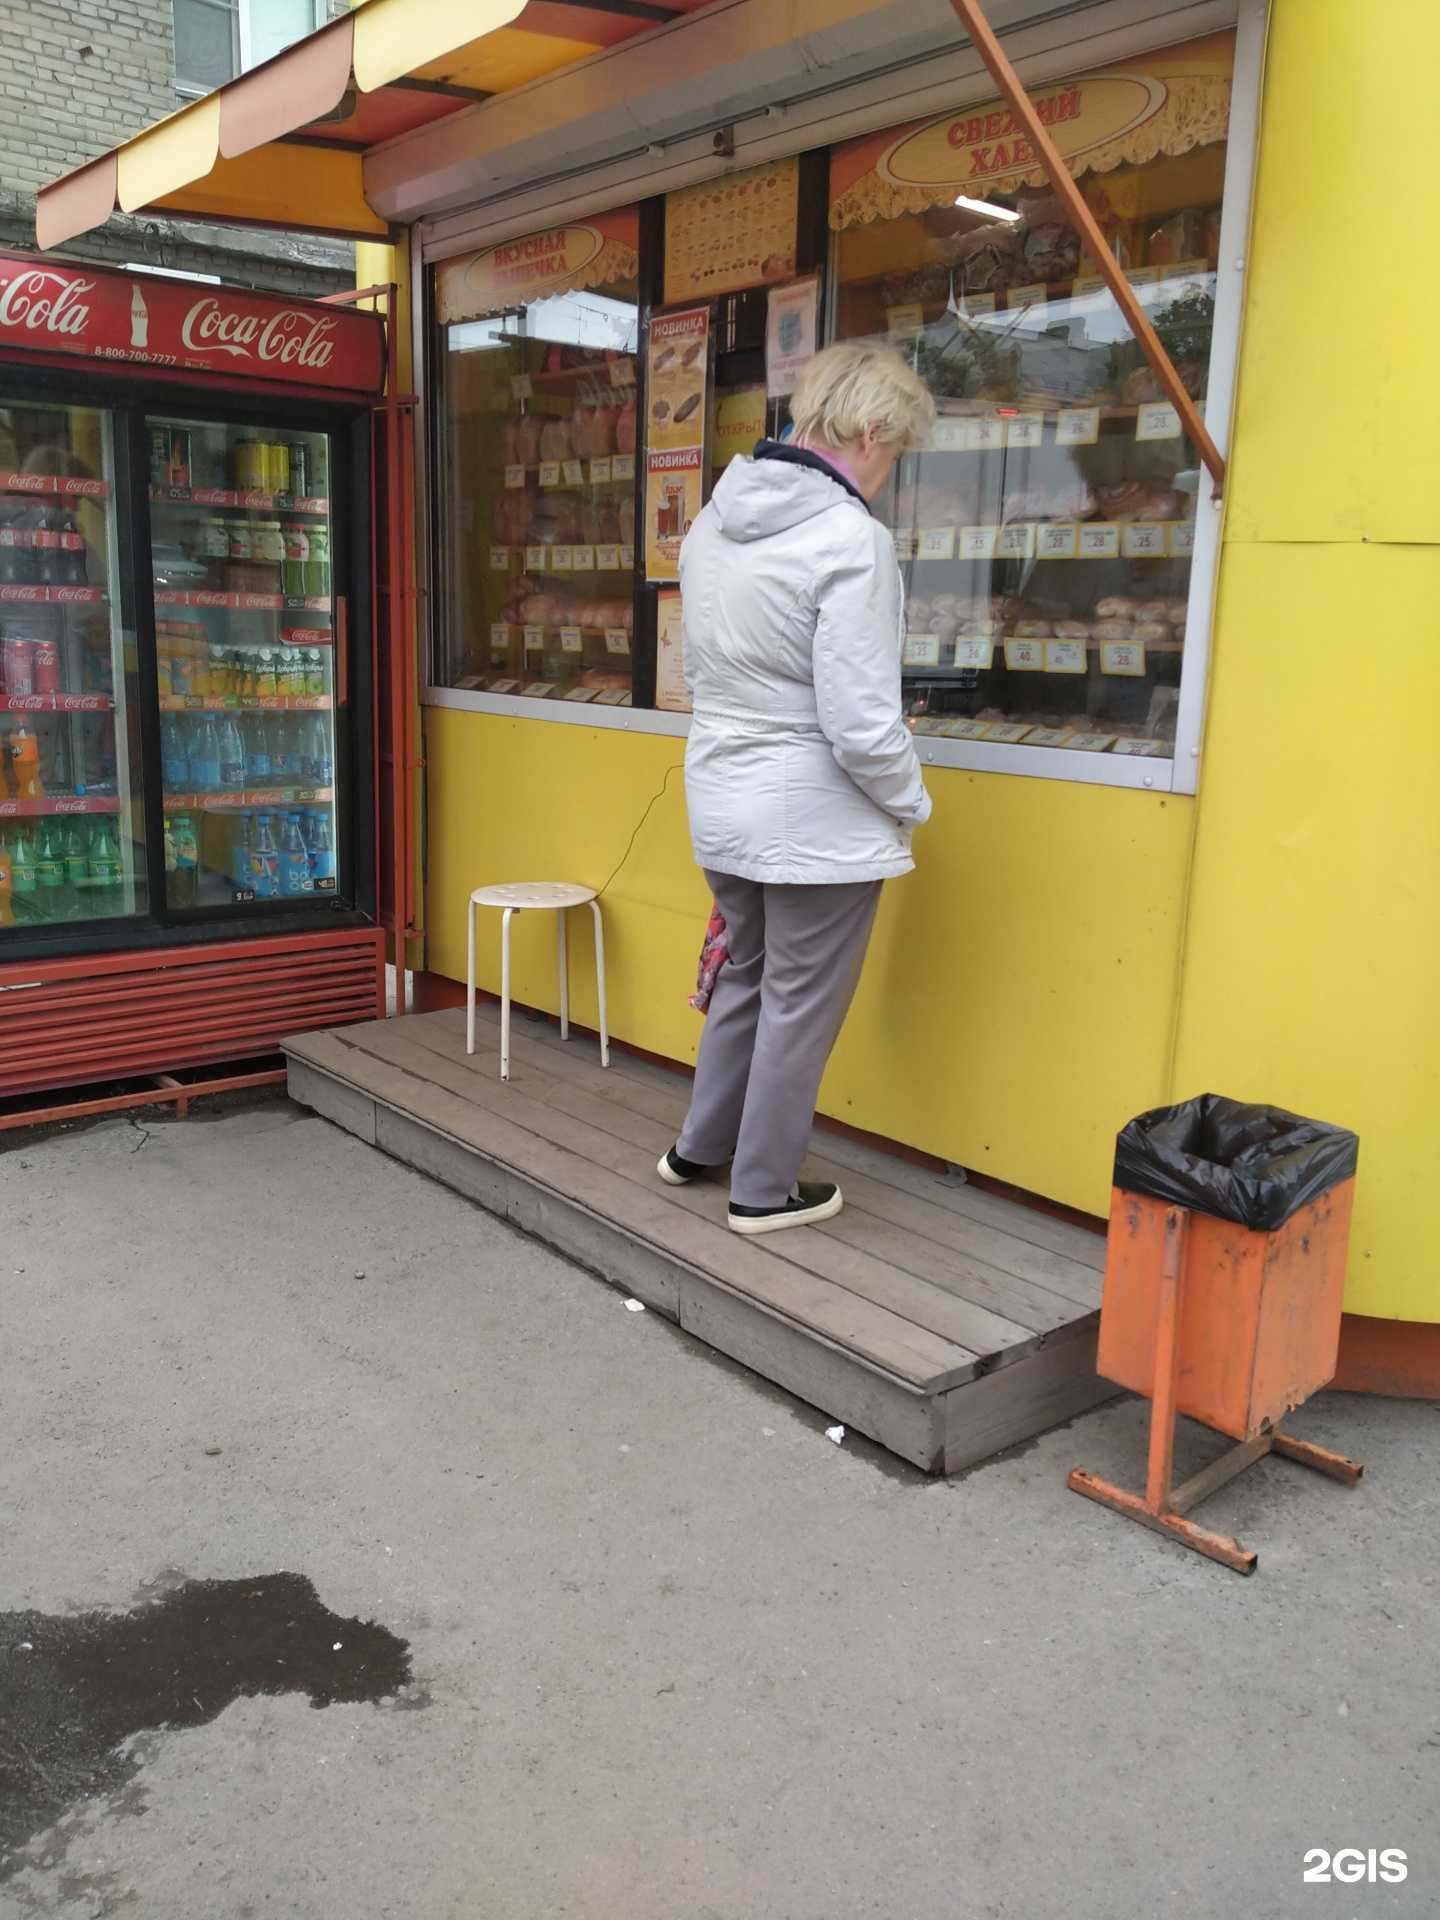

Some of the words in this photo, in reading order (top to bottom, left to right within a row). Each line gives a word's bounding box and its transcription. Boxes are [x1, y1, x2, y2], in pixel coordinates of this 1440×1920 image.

[968, 131, 1052, 176] ХЛЕ
[494, 230, 567, 266] ВКУСНАЯ
[182, 298, 338, 368] Coca-Cola
[654, 315, 704, 337] НОВИНКА
[95, 346, 177, 365] 8-800-700-7777
[651, 452, 699, 468] НОВИНКА
[8, 474, 44, 489] Coca-Cola
[65, 480, 101, 494] Coca-Cola
[1, 585, 37, 600] Coca-Cola
[57, 588, 93, 602] Coca-Cola
[291, 630, 321, 642] Coca-Cola
[8, 697, 45, 709] Coca-Cola
[64, 697, 98, 709] Coca-Cola
[55, 801, 88, 811] Coca-Cola
